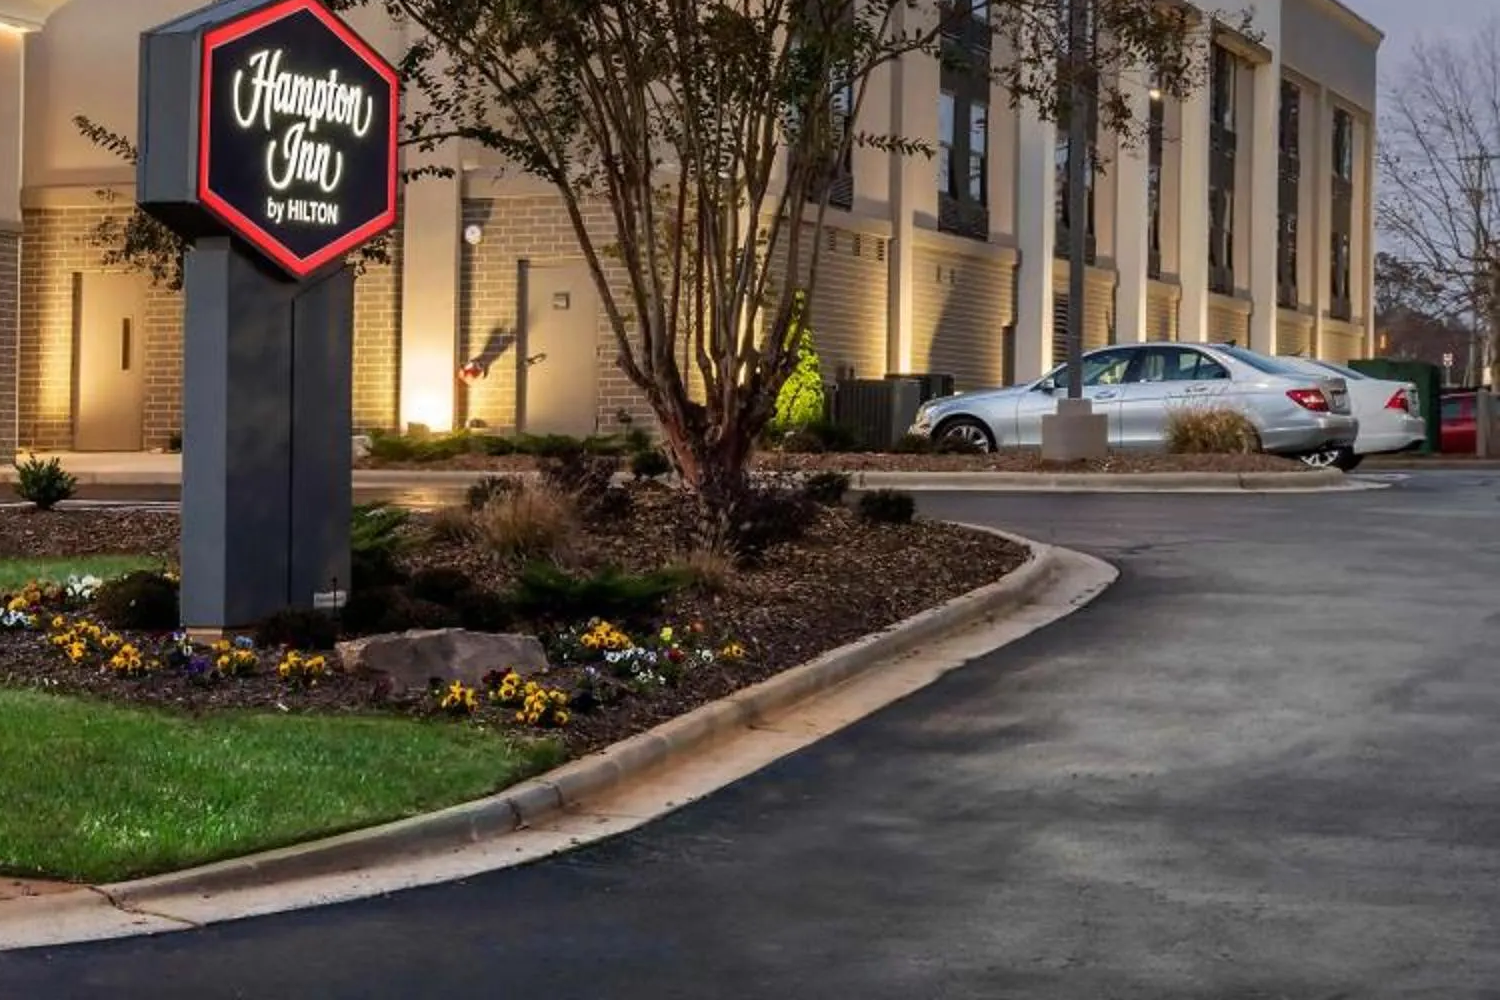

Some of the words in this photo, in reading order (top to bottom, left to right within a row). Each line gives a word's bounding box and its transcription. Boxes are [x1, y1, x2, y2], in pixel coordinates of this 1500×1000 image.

[233, 49, 373, 137] Hampton
[265, 121, 344, 193] Inn
[267, 197, 285, 224] by
[287, 200, 339, 225] HILTON
